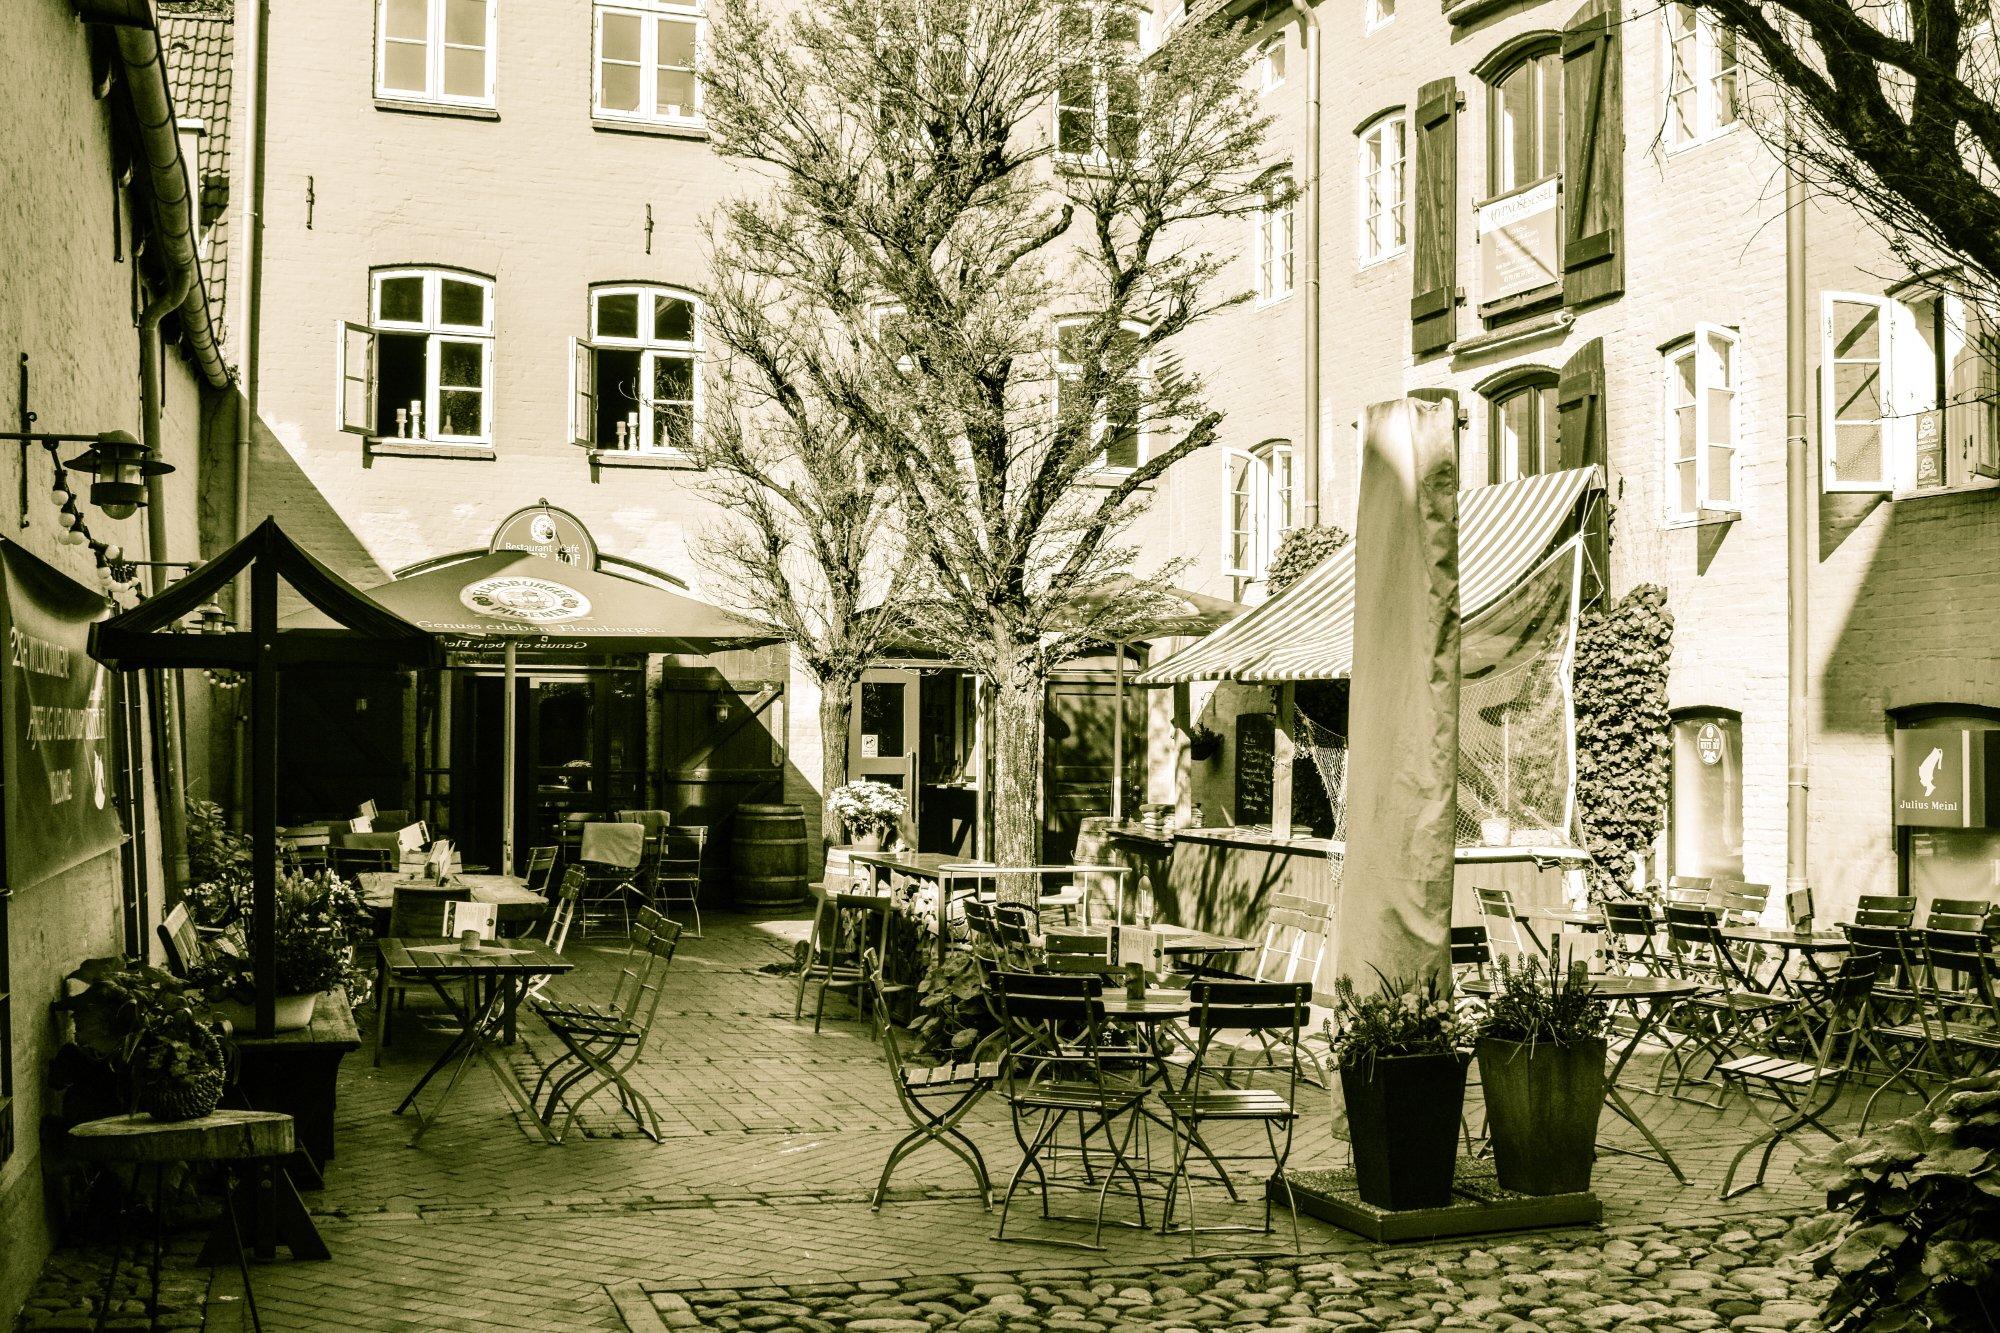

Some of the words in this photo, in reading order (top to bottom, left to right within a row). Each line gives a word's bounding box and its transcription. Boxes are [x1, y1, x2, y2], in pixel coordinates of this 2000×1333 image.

[505, 542, 553, 552] Restaurant
[560, 543, 580, 553] Café
[473, 580, 573, 599] FLENSBURGER
[491, 607, 571, 618] PILSENER
[416, 620, 482, 630] Genuss
[486, 621, 555, 633] erleben.
[558, 624, 666, 635] Flensburger.
[1899, 800, 1929, 810] Julius
[1931, 801, 1958, 811] Meinl
